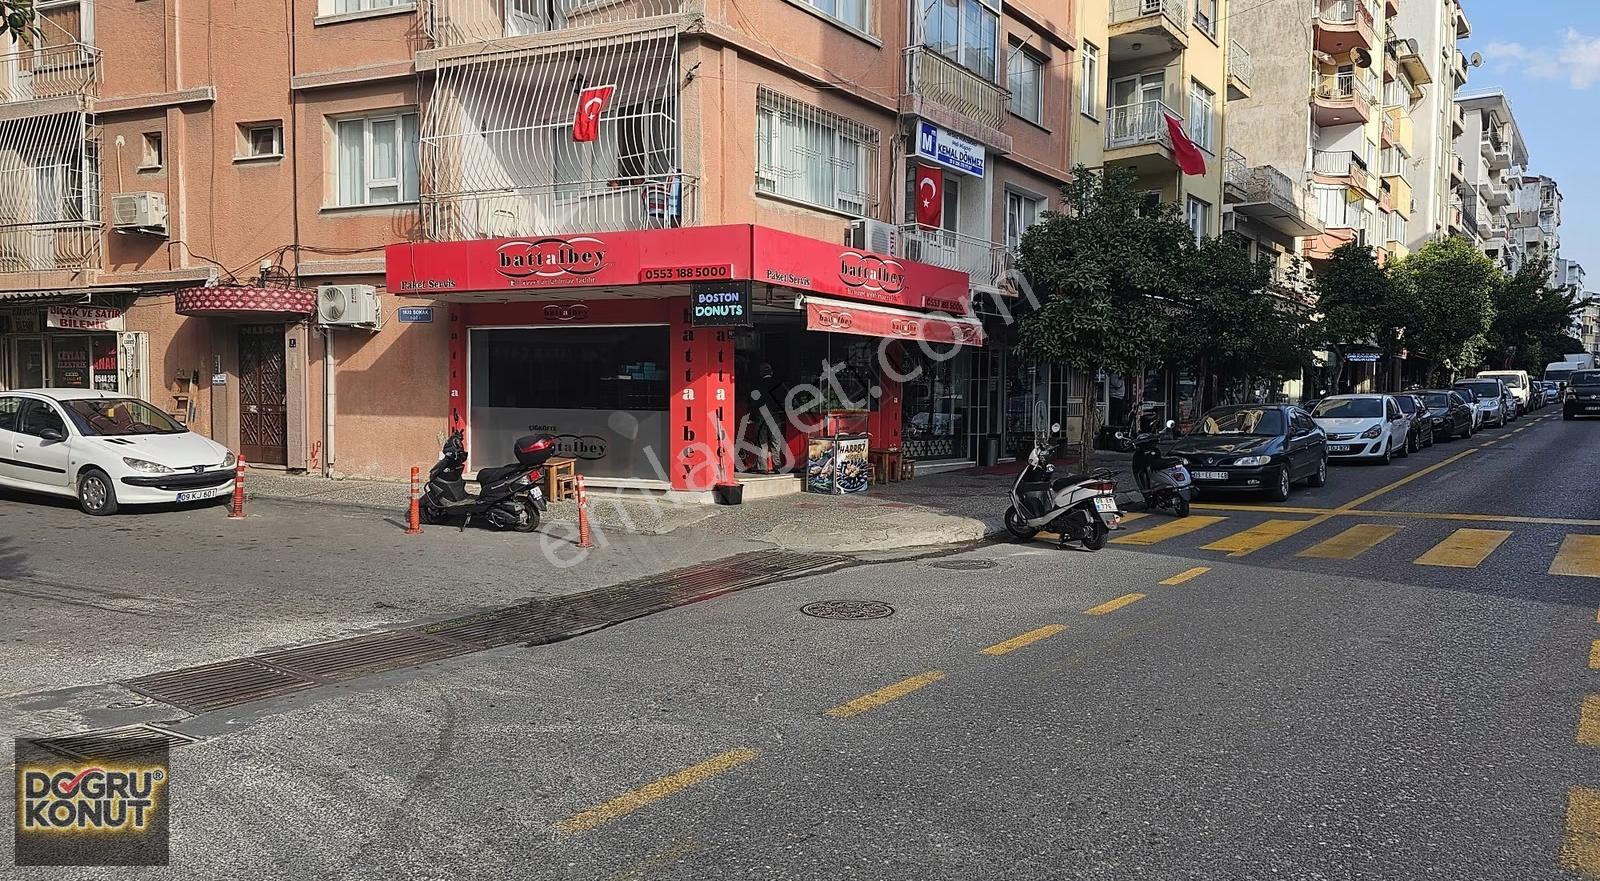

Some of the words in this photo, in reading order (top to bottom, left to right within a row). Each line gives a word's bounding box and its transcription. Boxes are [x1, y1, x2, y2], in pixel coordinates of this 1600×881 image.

[937, 143, 958, 159] KEMAL
[499, 248, 606, 268] battalbey
[645, 269, 673, 280] 0553
[676, 268, 693, 279] 188
[695, 266, 726, 277] 5000
[767, 269, 788, 281] Paket
[788, 273, 810, 286] Servis
[841, 259, 904, 288] battalbey
[400, 279, 426, 290] Paket
[428, 278, 456, 289] Servis
[698, 292, 739, 304] BOSTON
[82, 309, 94, 318] VE
[695, 304, 743, 317] DONUTS
[94, 374, 107, 383] 0544
[181, 493, 190, 501] 09
[203, 490, 215, 498] 601
